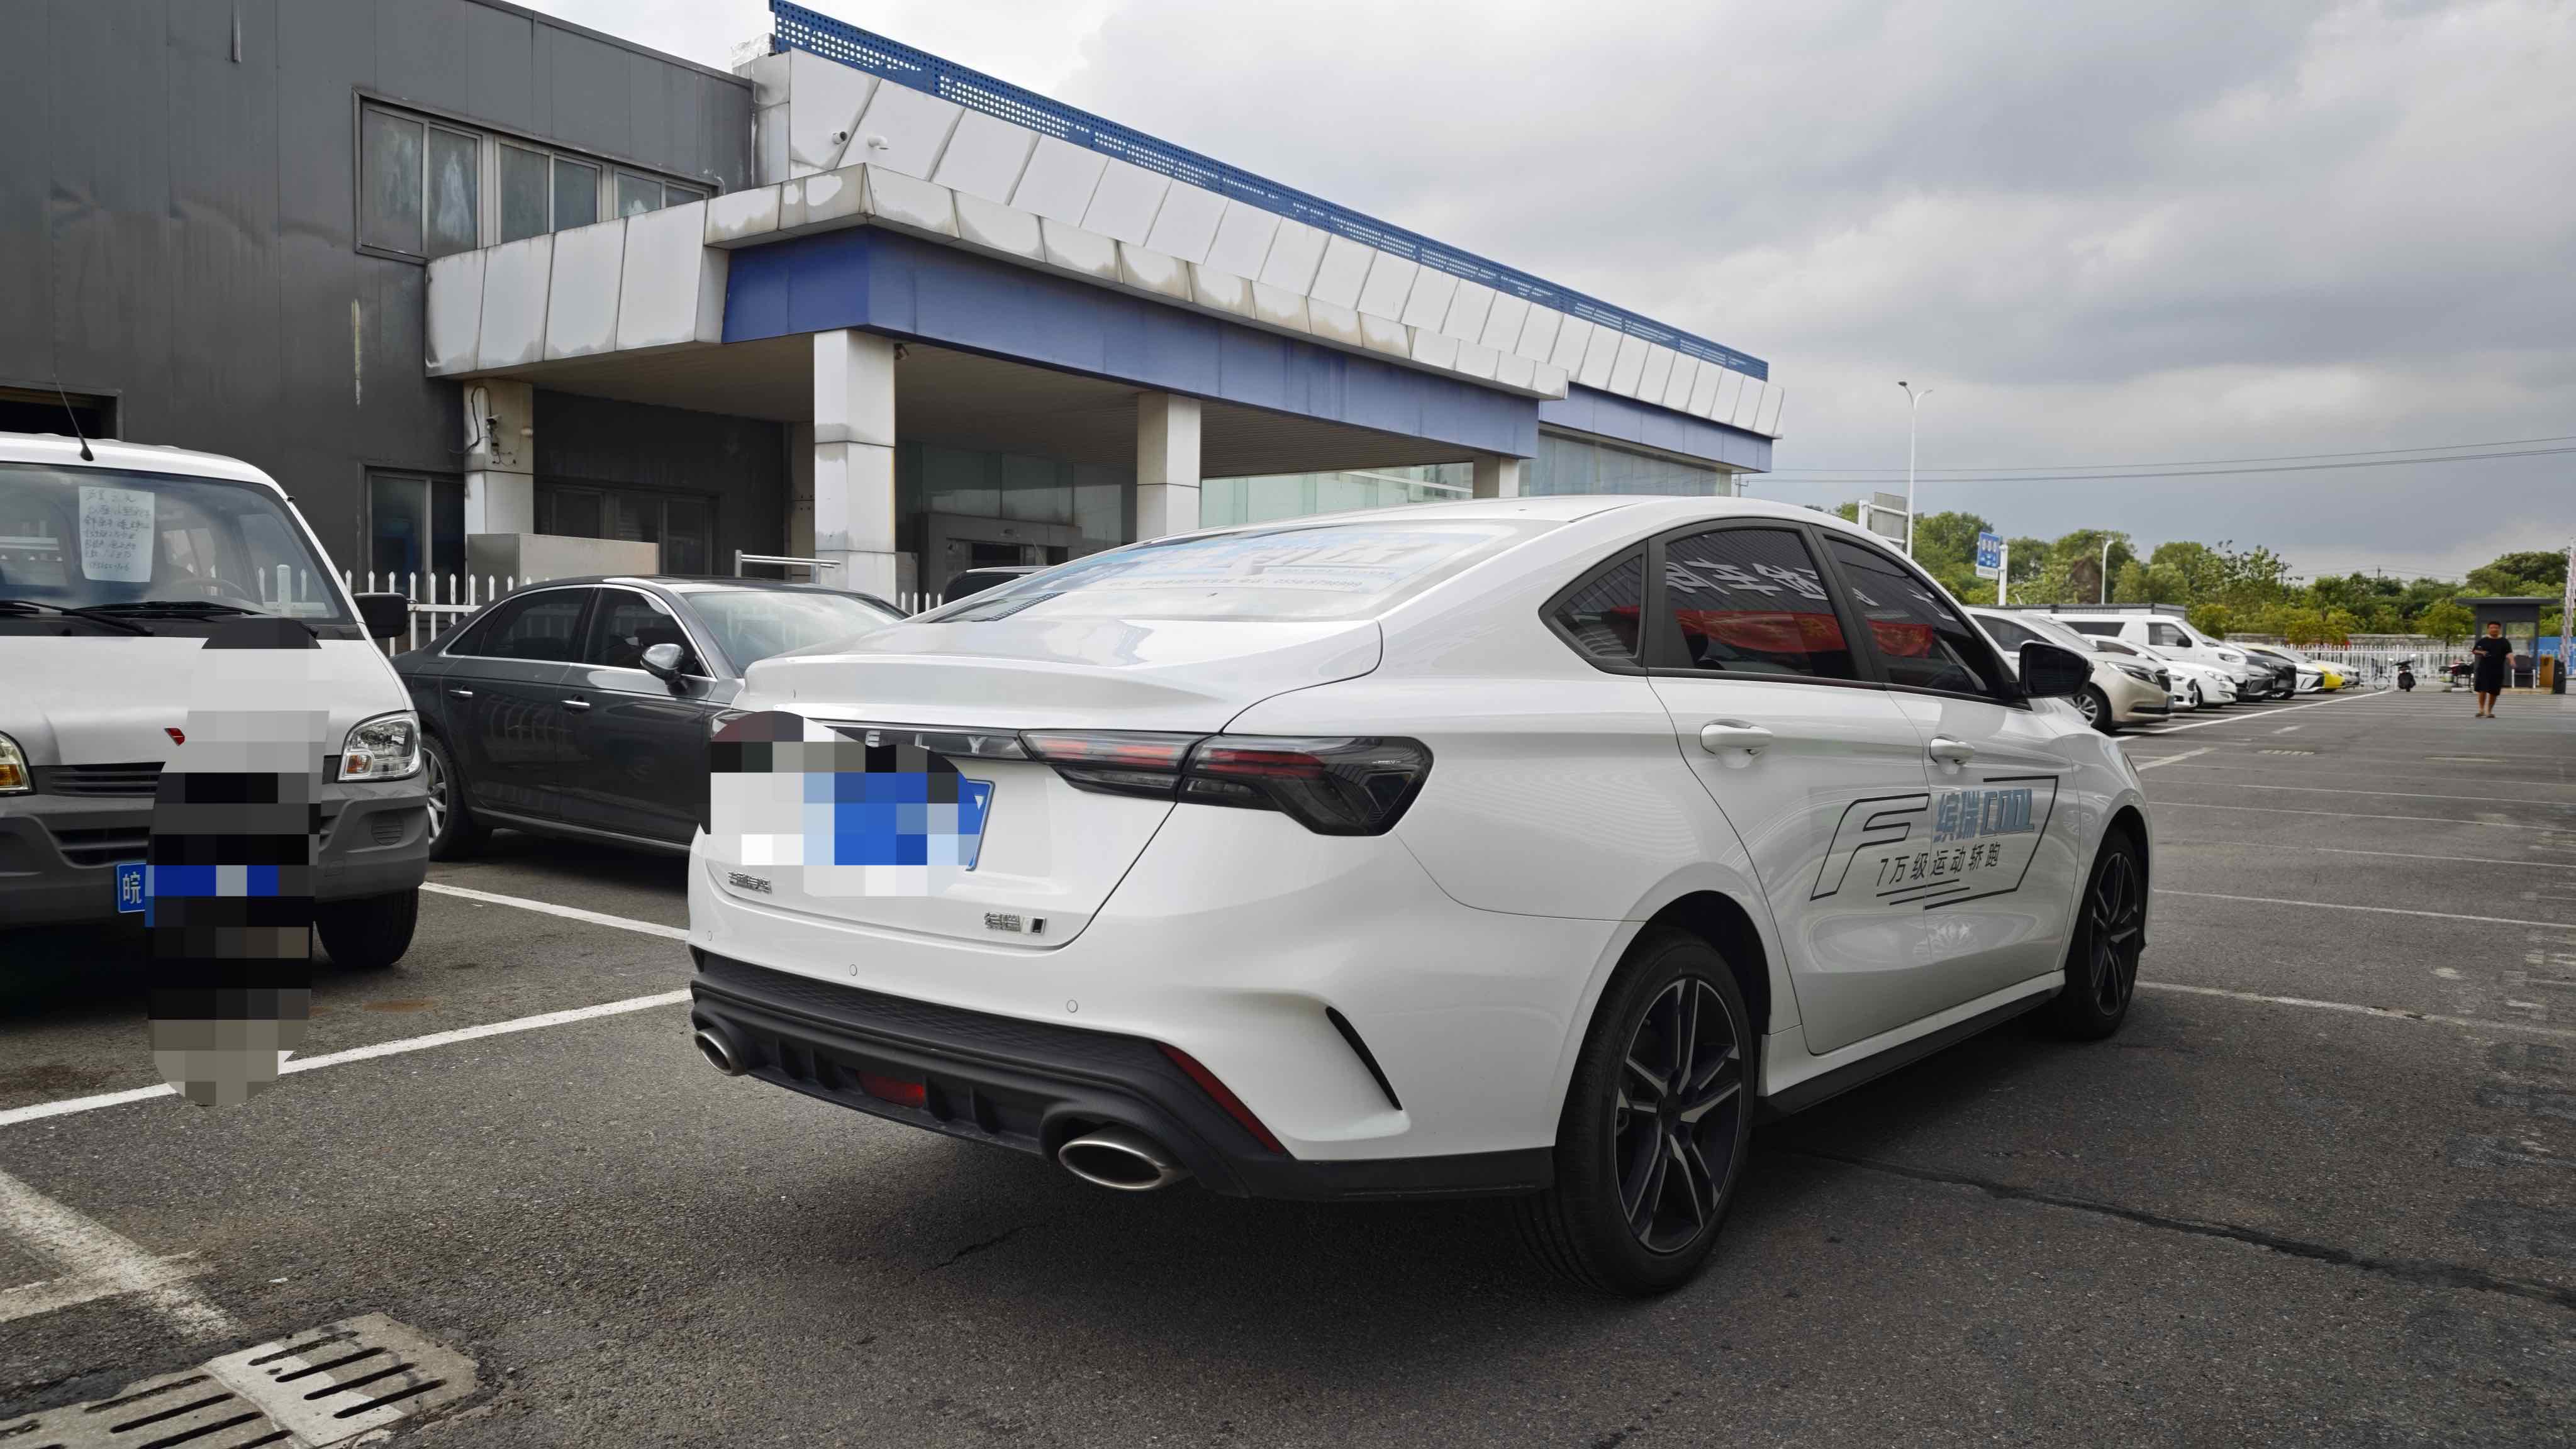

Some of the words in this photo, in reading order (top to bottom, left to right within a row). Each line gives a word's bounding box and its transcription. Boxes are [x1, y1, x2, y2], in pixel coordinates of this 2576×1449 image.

[865, 729, 988, 755] ELY
[1876, 841, 2002, 887] 7万级运动轿跑
[122, 871, 142, 904] 皖
